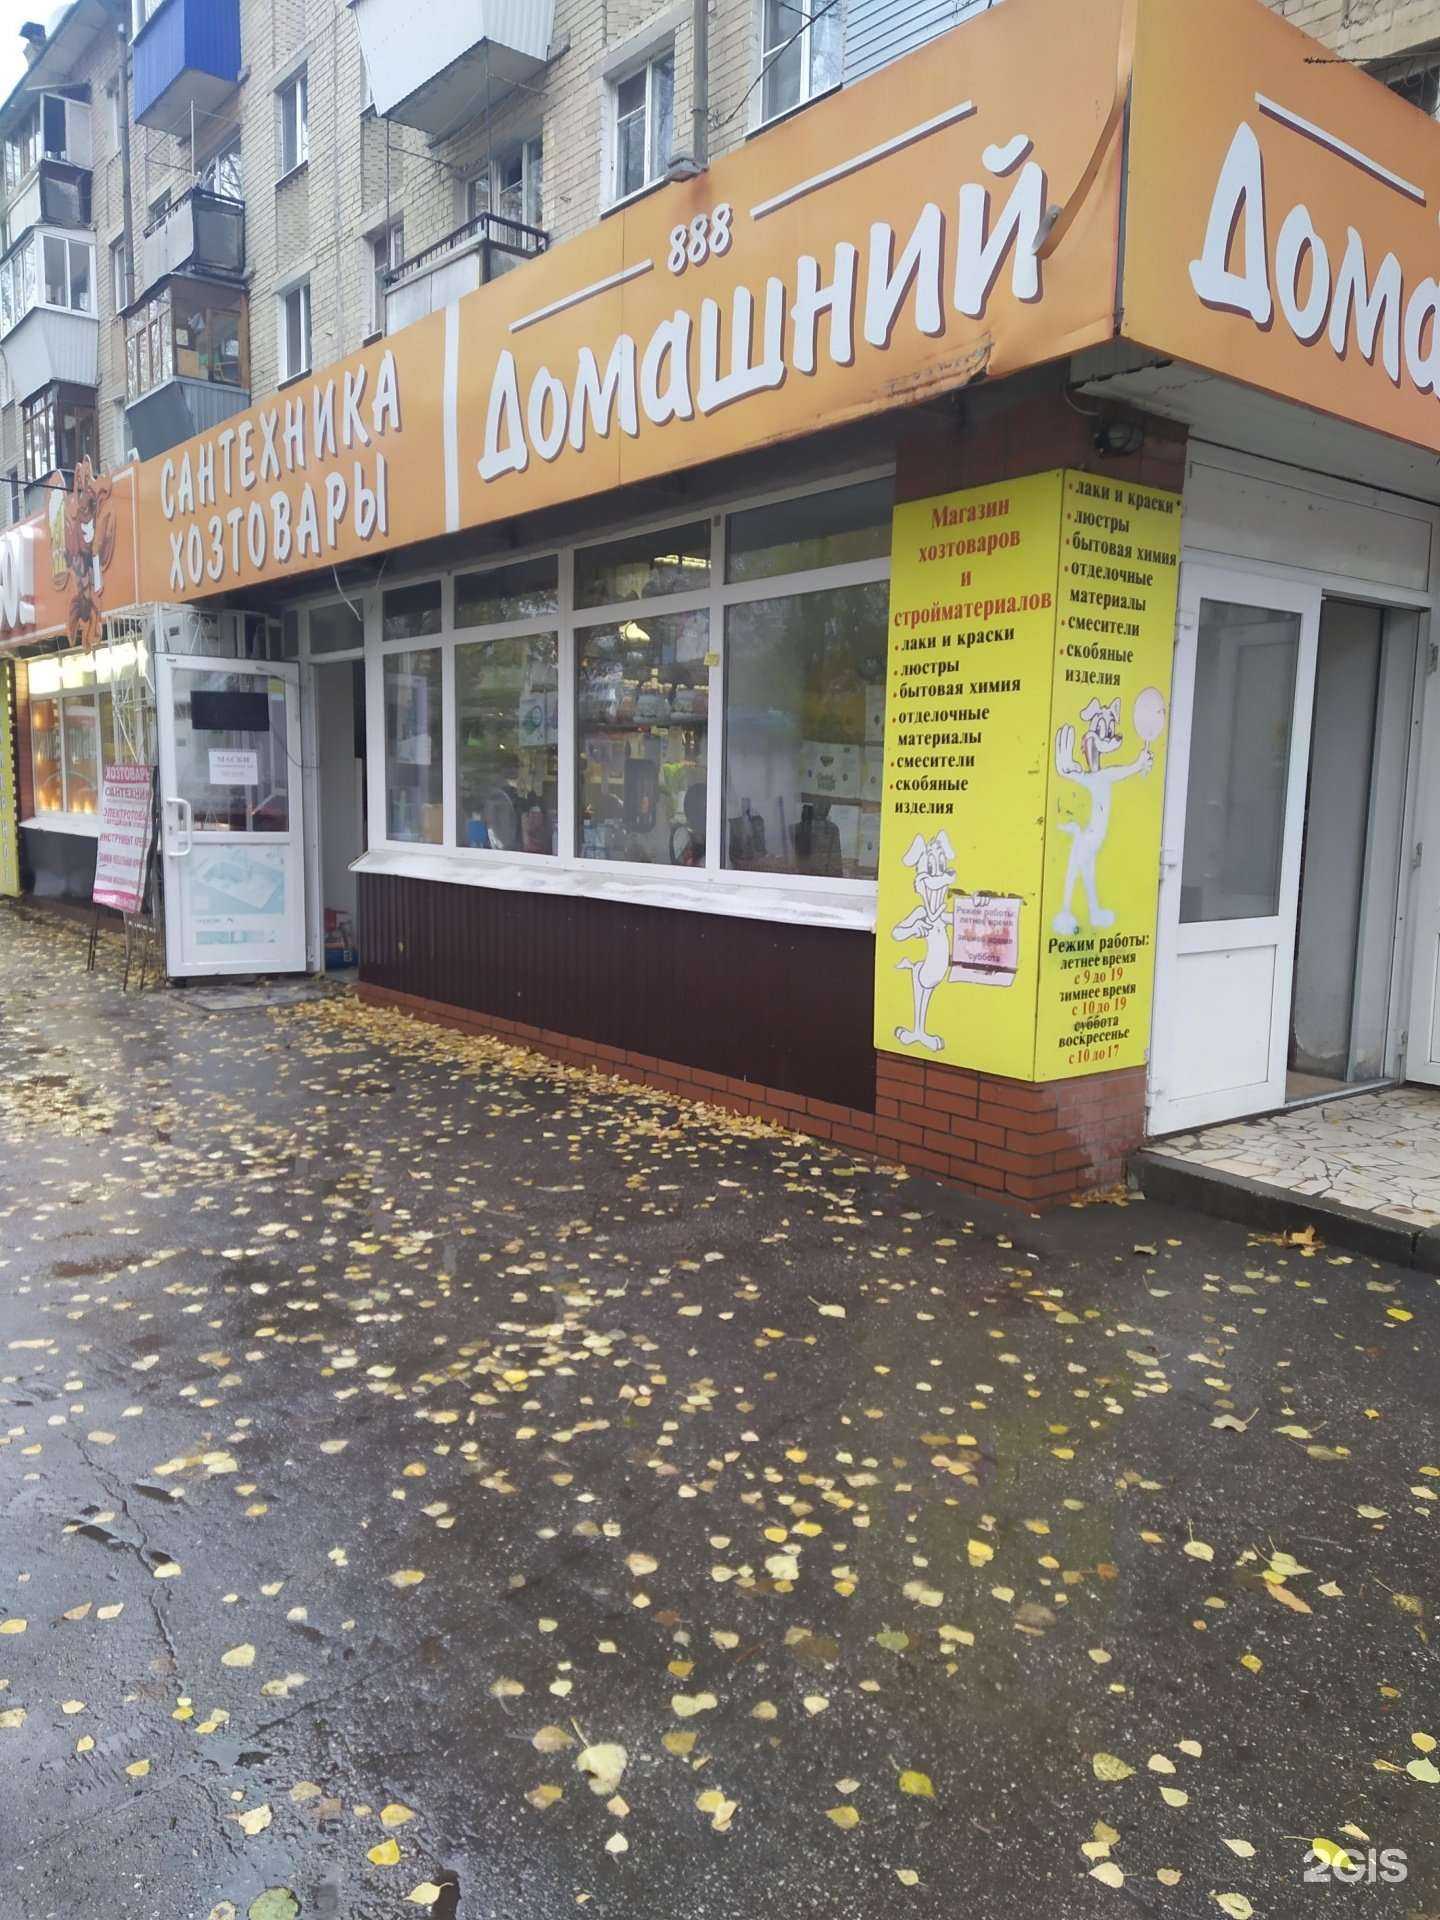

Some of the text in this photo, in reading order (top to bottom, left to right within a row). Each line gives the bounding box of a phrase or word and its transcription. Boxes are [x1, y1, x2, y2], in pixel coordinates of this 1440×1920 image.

[668, 203, 733, 275] 888
[161, 350, 400, 519] САНТЕХНИКА
[1075, 480, 1173, 513] лаки и краски
[170, 452, 387, 590] ХОЗТОВАРЫ
[931, 499, 1010, 529] Магазин
[1074, 510, 1129, 534] люстры
[918, 530, 1021, 562] хозтоваров
[1072, 531, 1177, 566] бытовая химия
[960, 570, 972, 587] и
[1071, 562, 1153, 586] отделочные
[1070, 589, 1146, 611] материалы
[894, 592, 1052, 629] стройматериалов
[1068, 616, 1140, 636] смесители
[901, 627, 1015, 651] лаки и краски
[1066, 642, 1134, 663] скобяные
[900, 660, 960, 677] люстры
[1065, 669, 1121, 686] изделия
[900, 679, 1021, 699] бытовая химия
[898, 707, 990, 724] отделочные
[898, 731, 982, 748] материалы
[896, 755, 975, 768] смесители
[895, 775, 968, 791] скобяные
[895, 802, 953, 815] изделия
[1048, 933, 1149, 954] Режим работы:
[1060, 953, 1136, 970] летнее время
[1074, 967, 1123, 985] с 9 до 19
[1060, 983, 1136, 1002] зимнее время
[1072, 997, 1127, 1016] с 10 до 19
[1074, 1016, 1119, 1033] суббота
[1058, 1029, 1130, 1048] воскресенье
[1069, 1044, 1119, 1064] с 10 до 17
